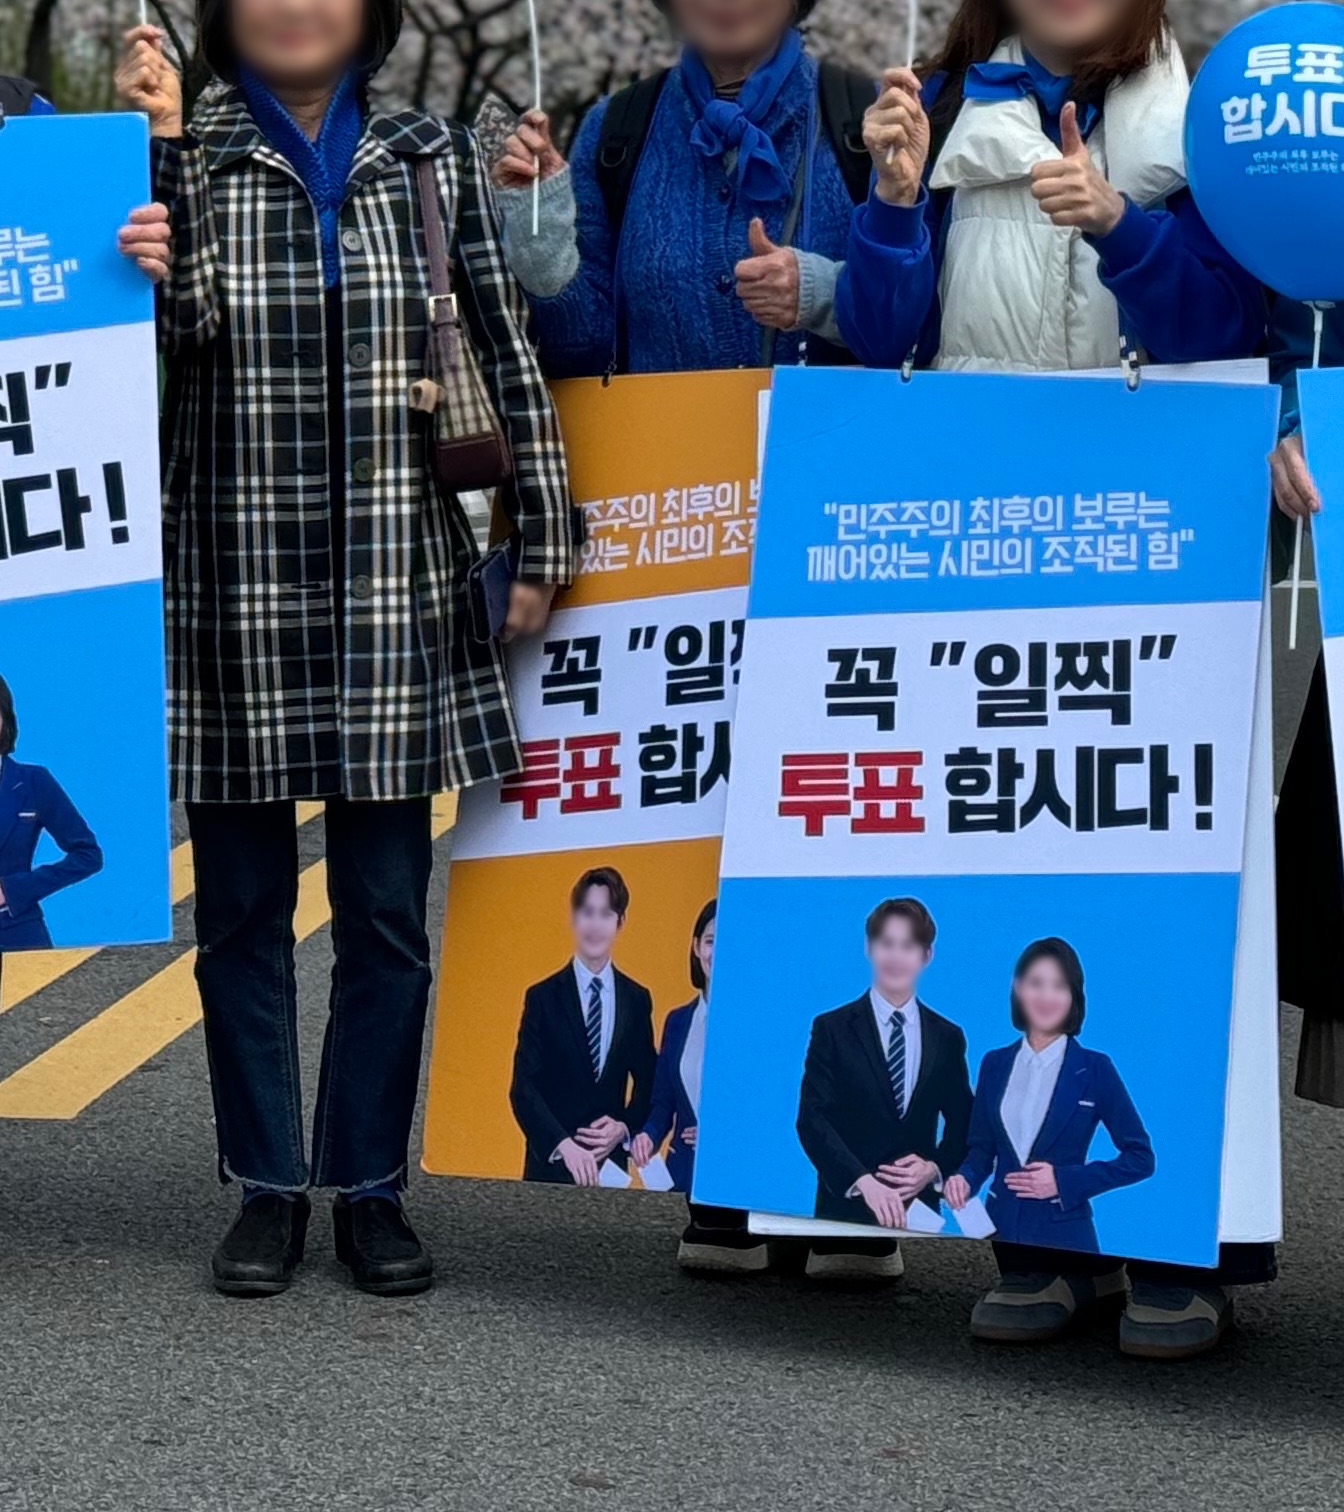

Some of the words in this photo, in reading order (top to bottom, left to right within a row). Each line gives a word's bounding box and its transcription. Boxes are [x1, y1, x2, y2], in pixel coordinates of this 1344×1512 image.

[1244, 43, 1344, 86] 투표
[30, 260, 78, 302] 힘"
[580, 491, 656, 536] 주주의
[662, 478, 740, 524] 최후의
[825, 500, 961, 541] "민주주의
[969, 496, 1063, 536] 최후의
[1071, 491, 1170, 532] 보루는
[579, 536, 631, 575] 있는
[636, 523, 713, 565] 시민의
[807, 543, 930, 582] 깨어있는
[938, 538, 1032, 578] 시민의
[1040, 533, 1138, 573] 조직된
[1147, 530, 1194, 570] 힘"
[542, 635, 601, 716] 꼭
[825, 646, 899, 731] 꼭
[930, 634, 1177, 729] "일찍"
[500, 732, 622, 821] 투표
[778, 750, 926, 837] 투표
[944, 743, 1214, 834] 합시다!
